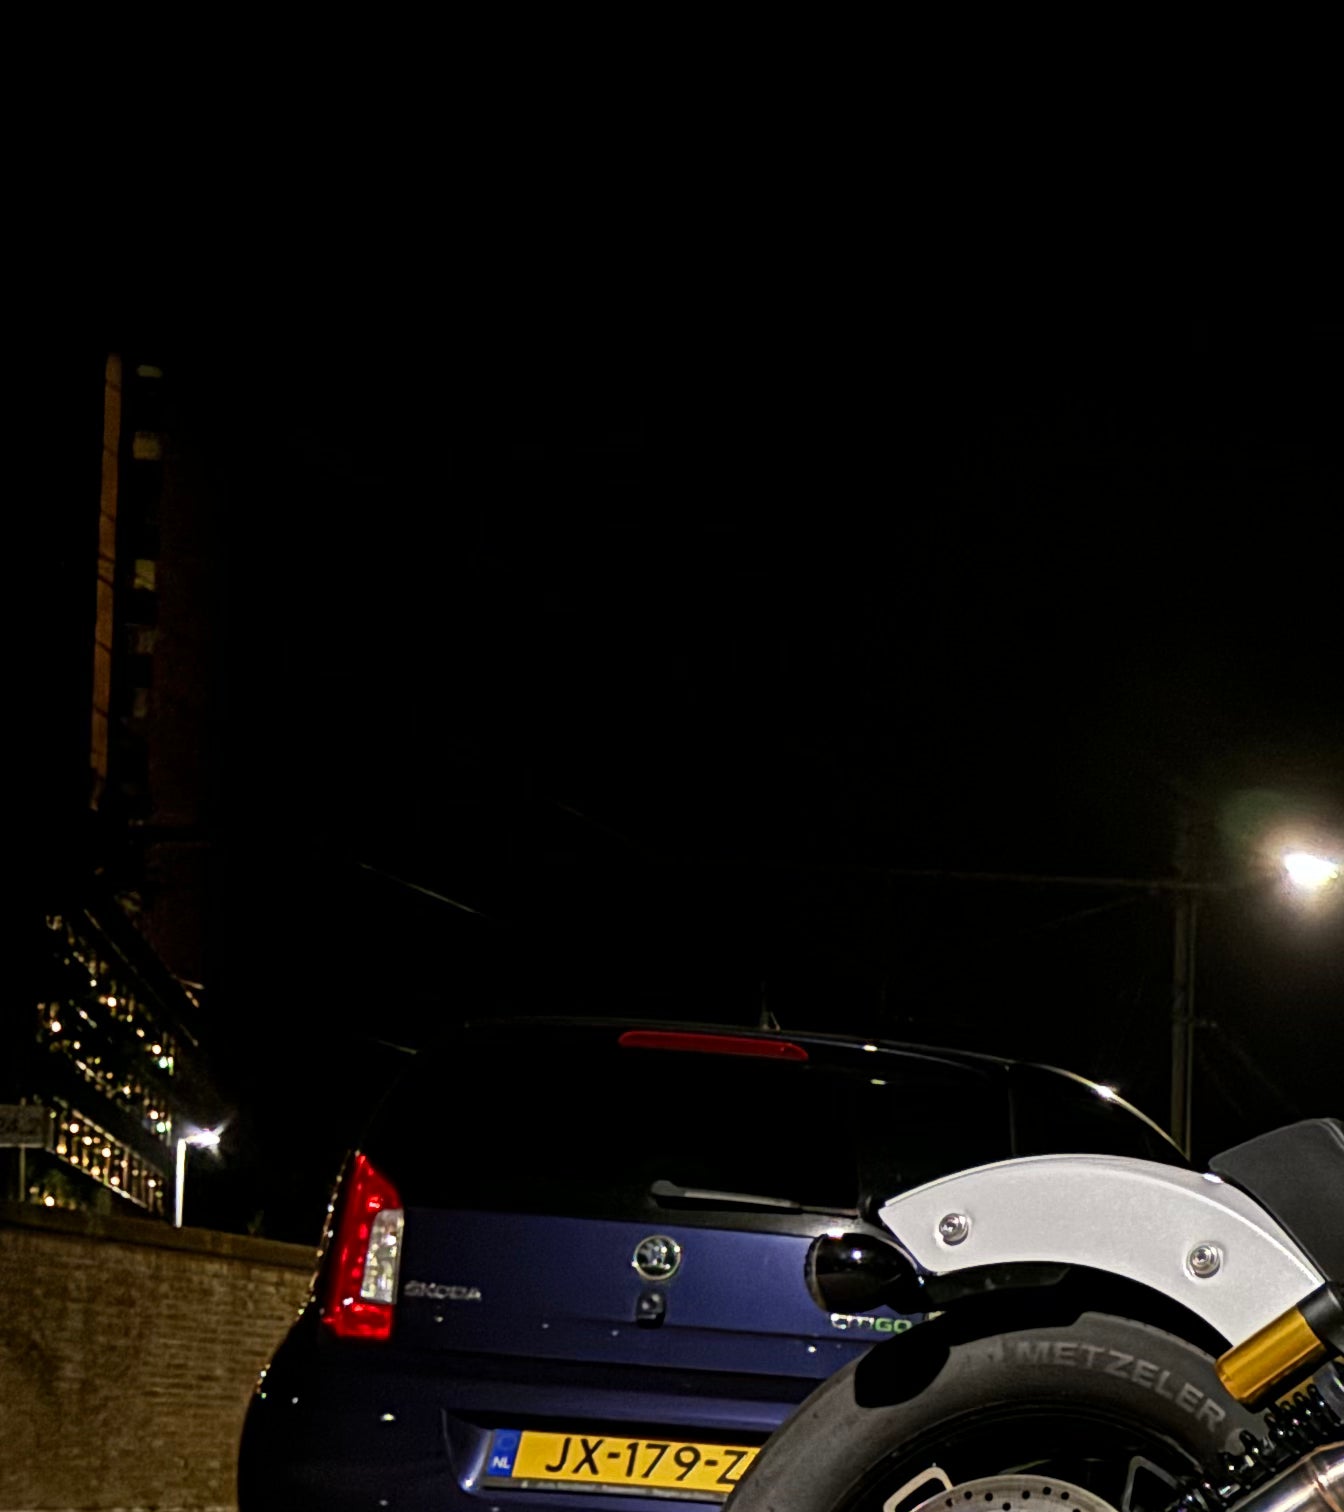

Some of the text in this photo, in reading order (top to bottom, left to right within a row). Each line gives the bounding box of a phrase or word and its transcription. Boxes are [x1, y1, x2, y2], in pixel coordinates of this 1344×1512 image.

[1013, 1340, 1226, 1432] METZELER
[493, 1455, 513, 1470] NL
[545, 1437, 748, 1484] JX-179-Z
